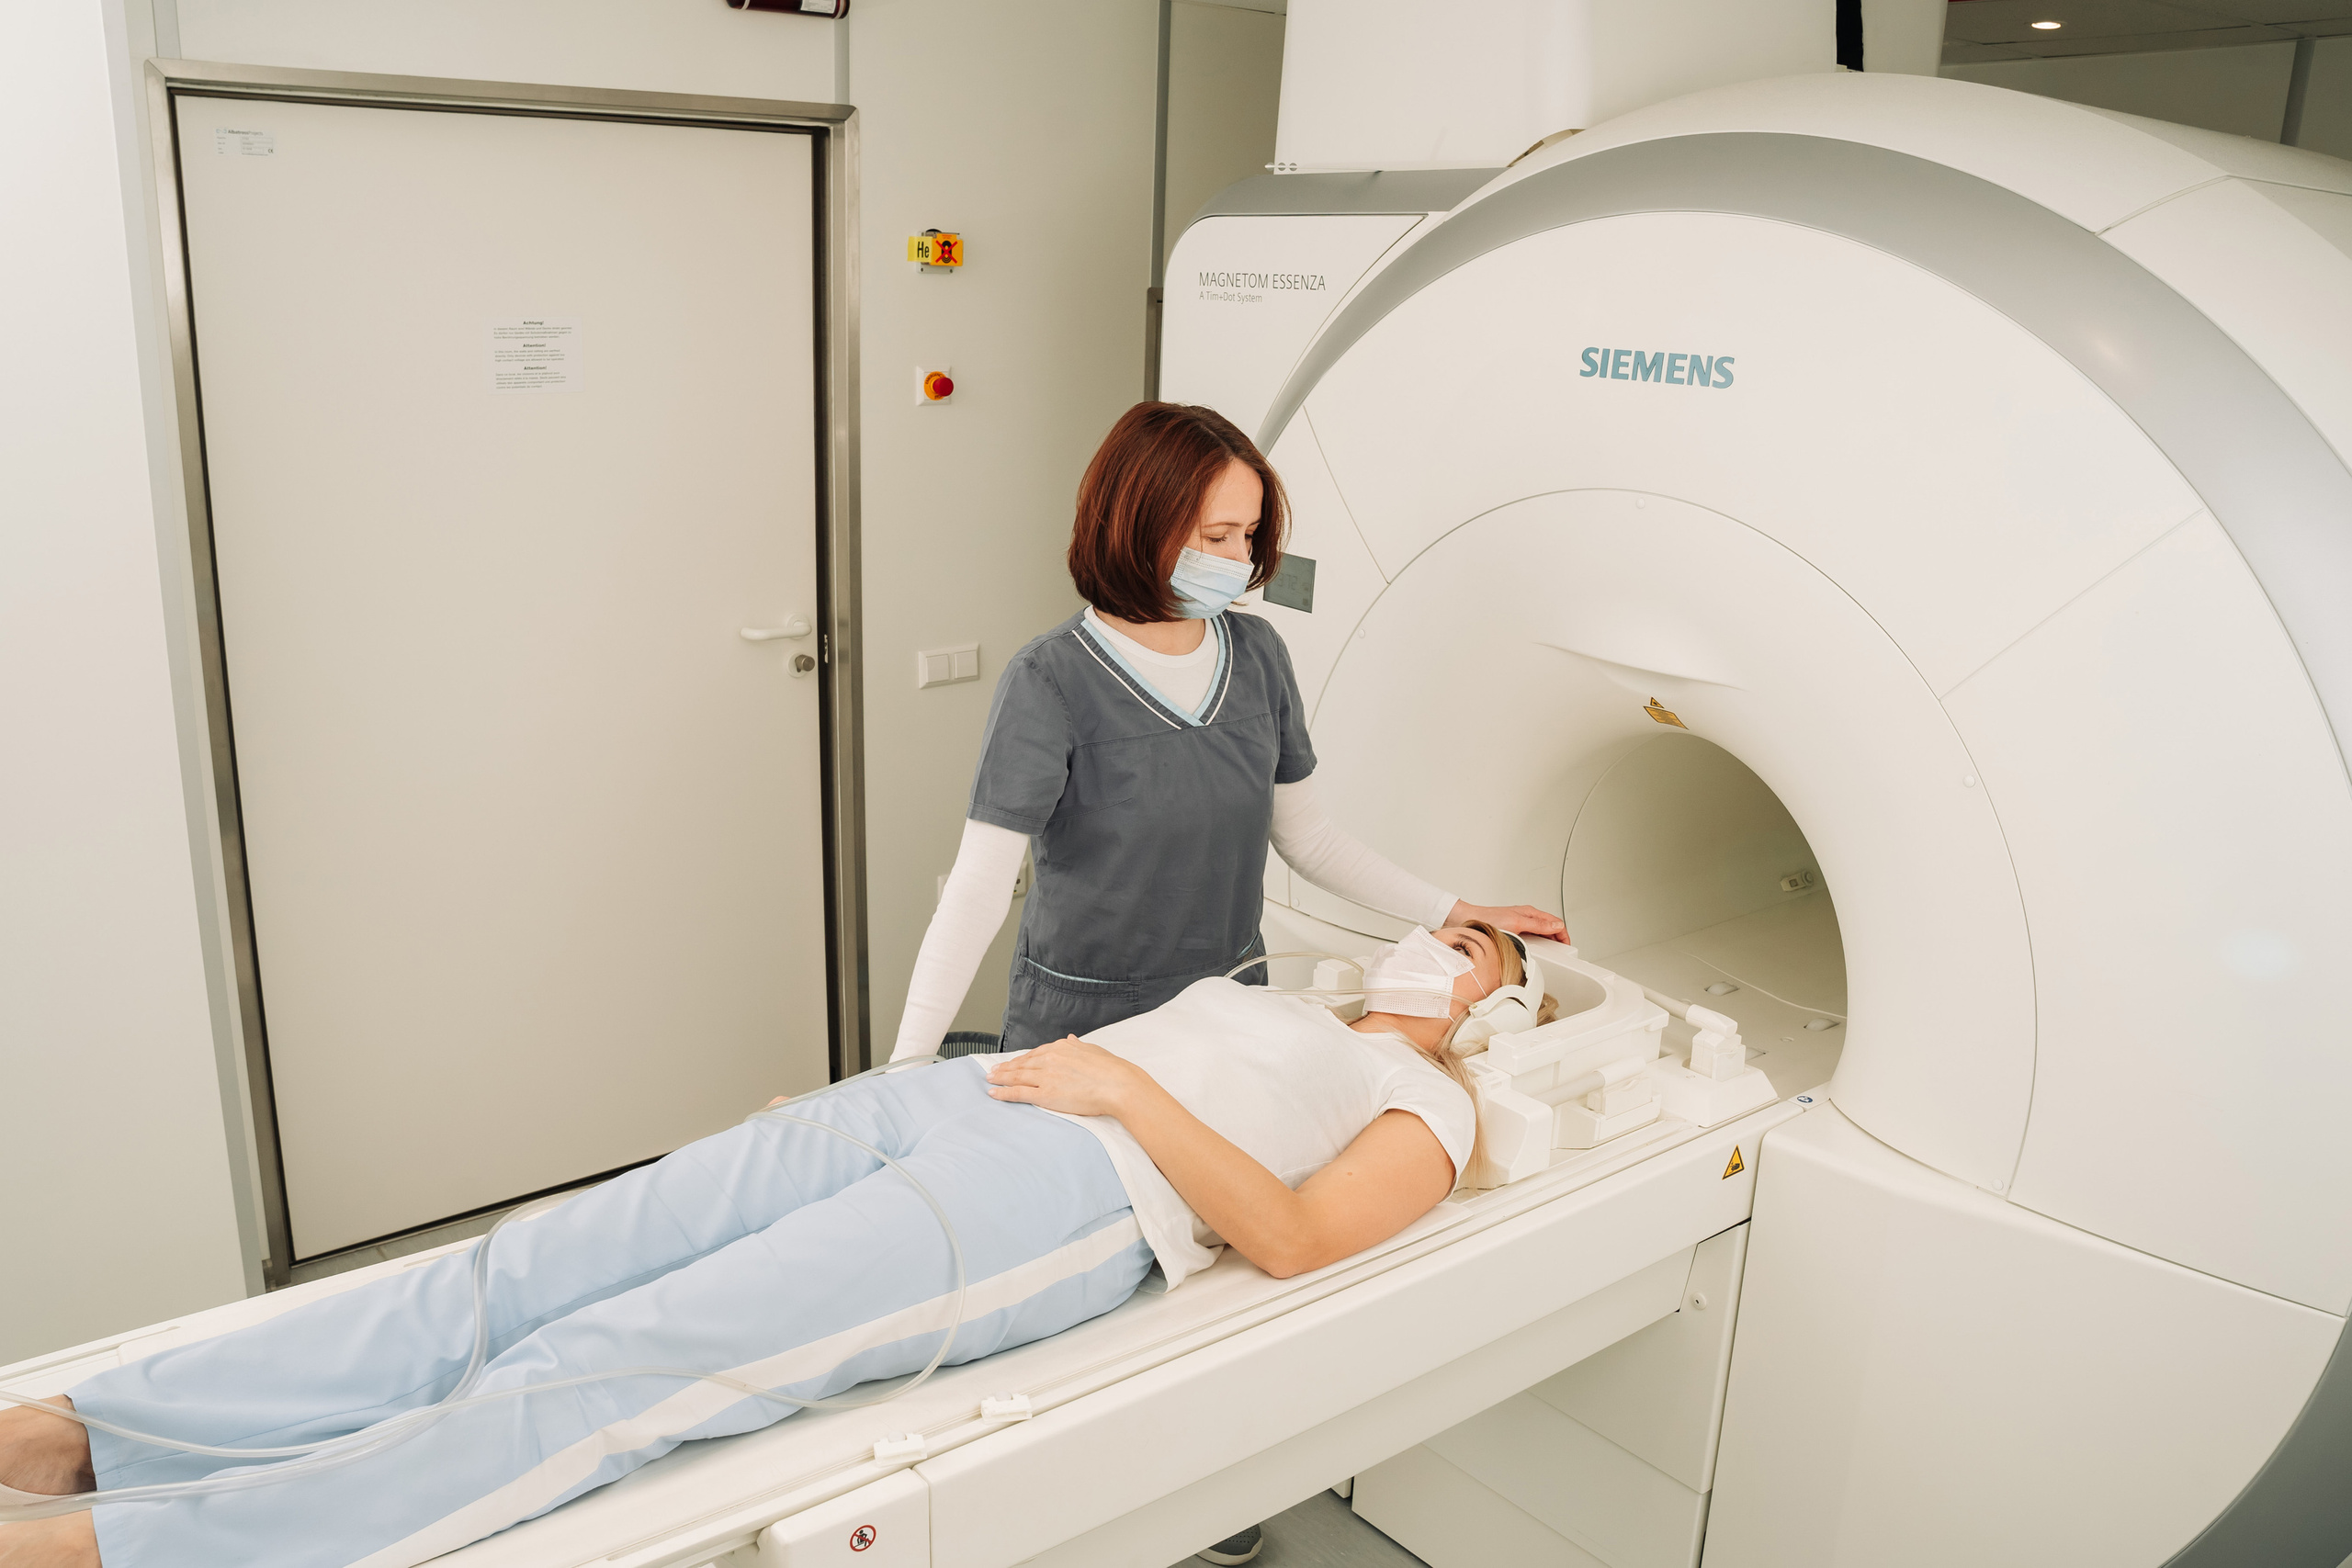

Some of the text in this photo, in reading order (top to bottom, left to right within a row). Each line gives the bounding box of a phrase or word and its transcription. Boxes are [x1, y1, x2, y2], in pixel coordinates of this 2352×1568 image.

[917, 241, 930, 258] He
[1199, 272, 1326, 291] MAGNETOM ESSENZA
[1199, 291, 1262, 305] A Tim+Dot System
[1579, 346, 1735, 389] SIEMENS
